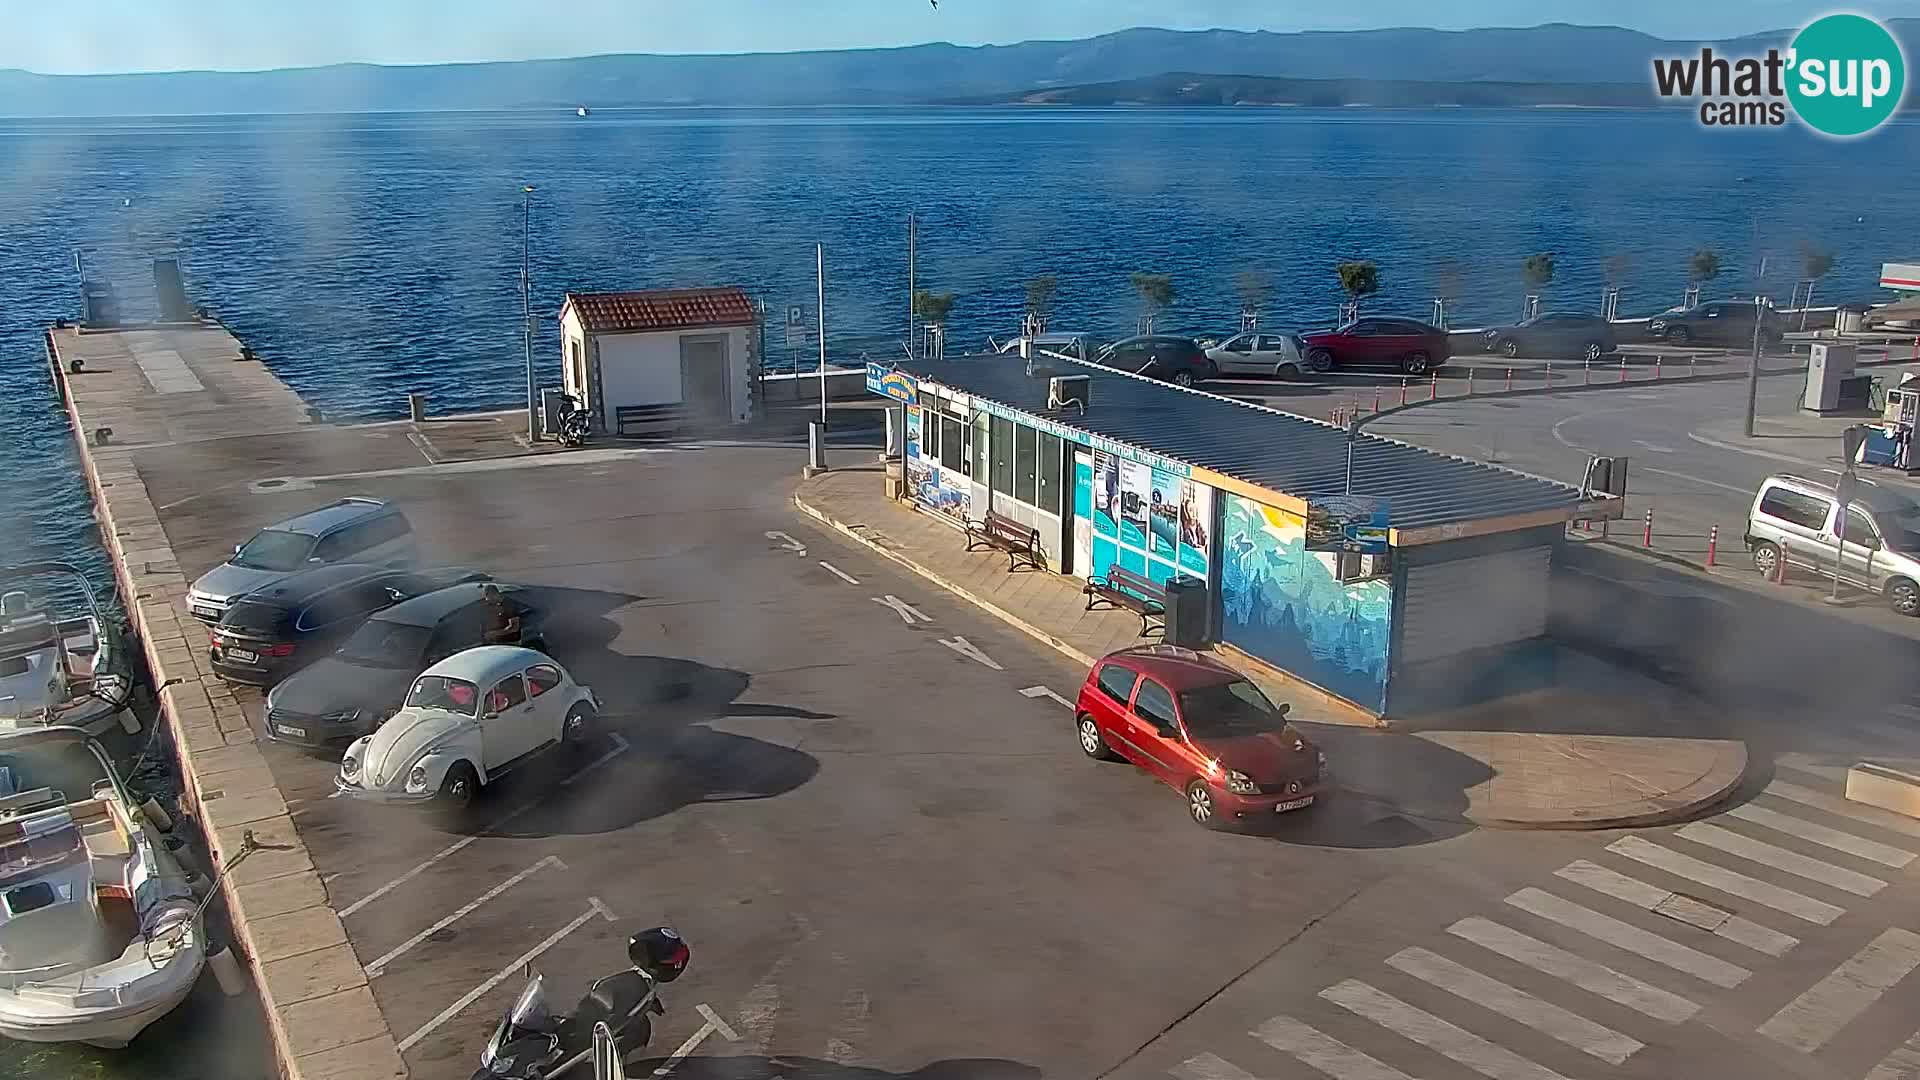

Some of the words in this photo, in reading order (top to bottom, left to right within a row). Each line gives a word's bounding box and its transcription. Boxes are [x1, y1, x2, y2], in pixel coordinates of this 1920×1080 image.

[791, 307, 801, 324] P
[1051, 422, 1080, 440] POSTAJA
[1104, 441, 1135, 460] STATION
[1135, 450, 1161, 469] TICKET
[1160, 459, 1187, 475] OFFICE
